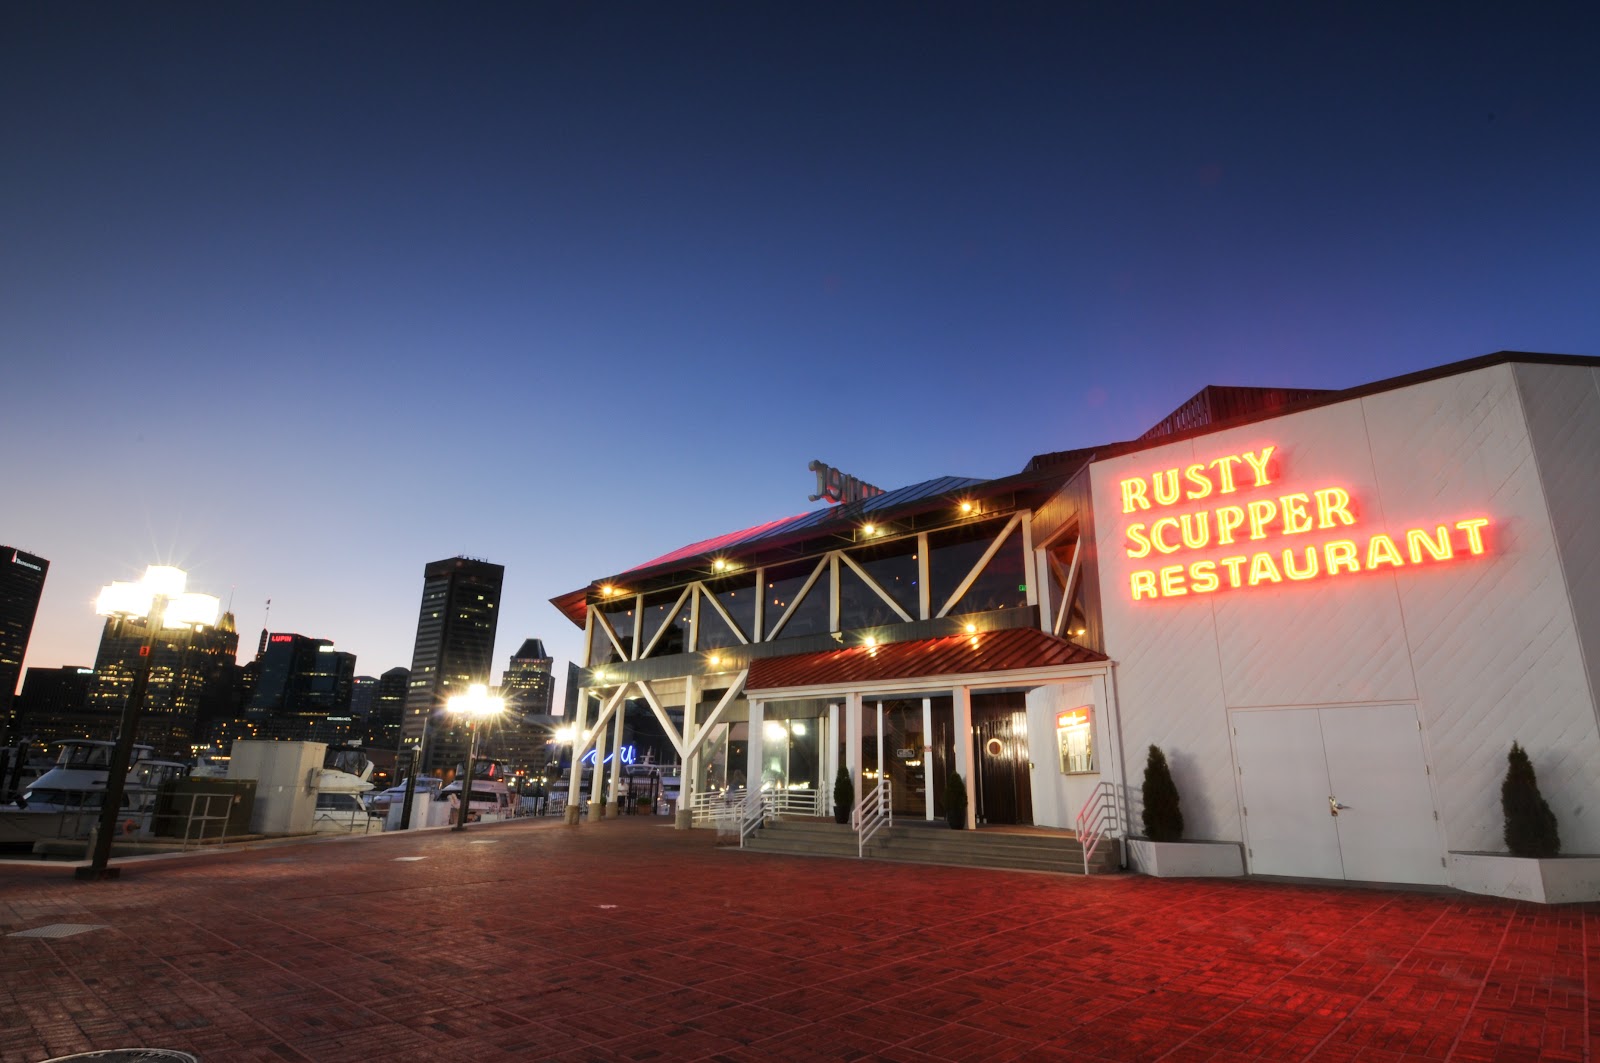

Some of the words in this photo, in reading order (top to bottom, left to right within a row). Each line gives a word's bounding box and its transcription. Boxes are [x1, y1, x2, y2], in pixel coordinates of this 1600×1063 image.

[1120, 446, 1275, 513] RUSTY
[1125, 487, 1356, 558] SCUPPER
[1130, 518, 1488, 600] RESTAURANT
